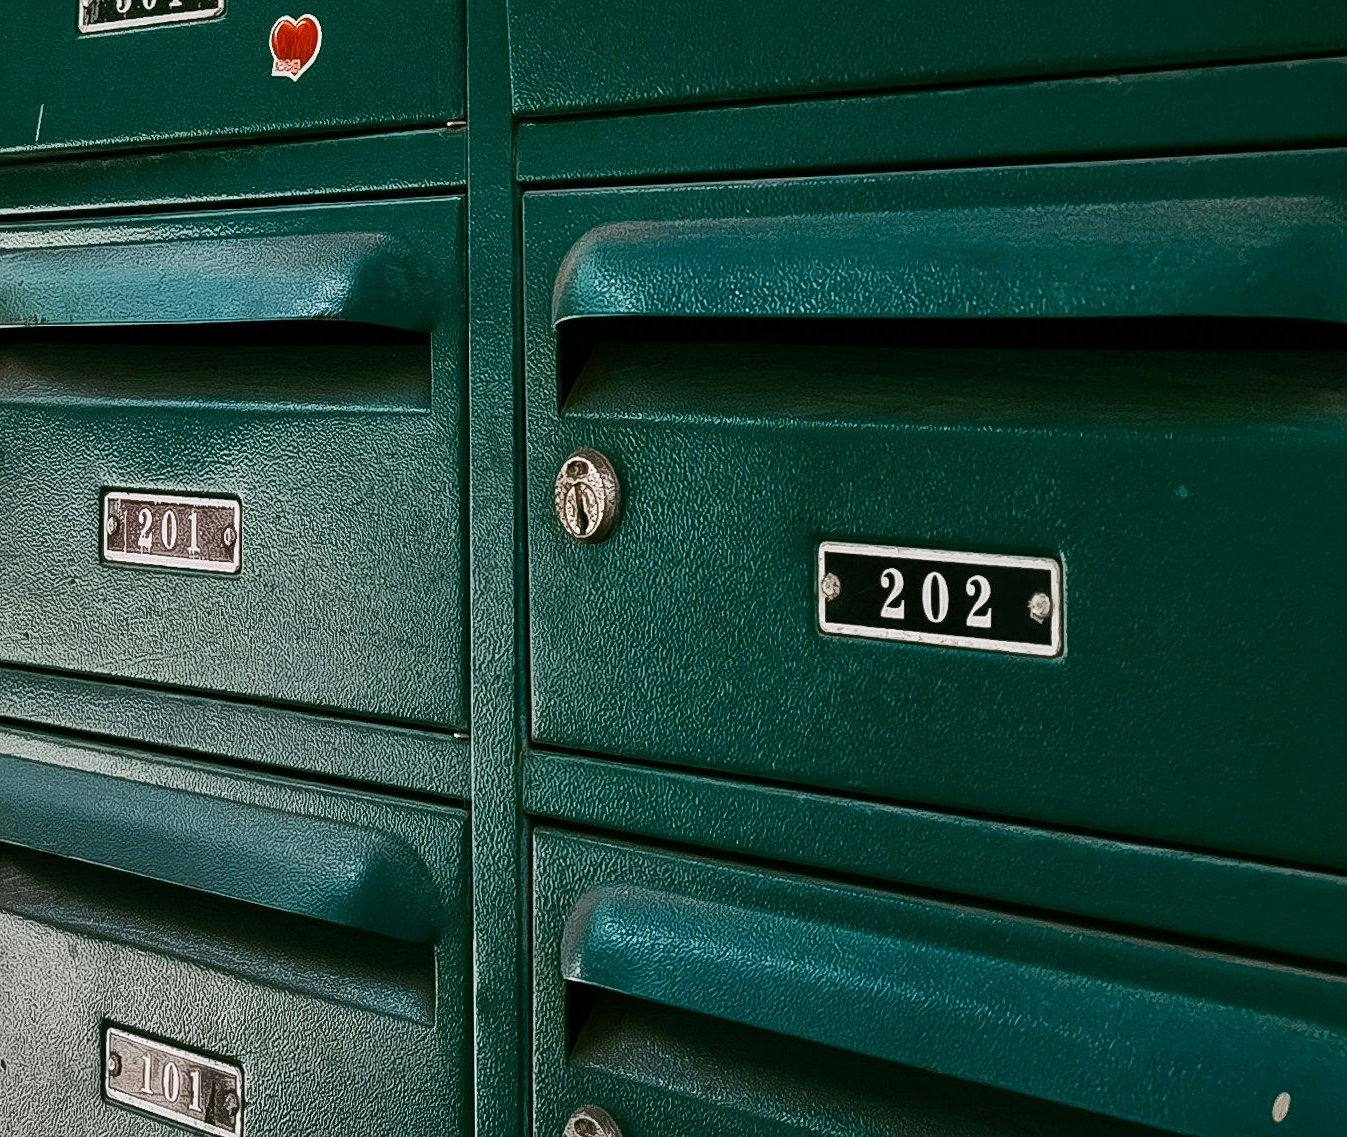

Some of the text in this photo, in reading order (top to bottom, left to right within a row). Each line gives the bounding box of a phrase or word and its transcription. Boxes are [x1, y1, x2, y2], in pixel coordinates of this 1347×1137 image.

[137, 506, 202, 551] 201
[880, 567, 992, 629] 202
[140, 1053, 203, 1112] 101
